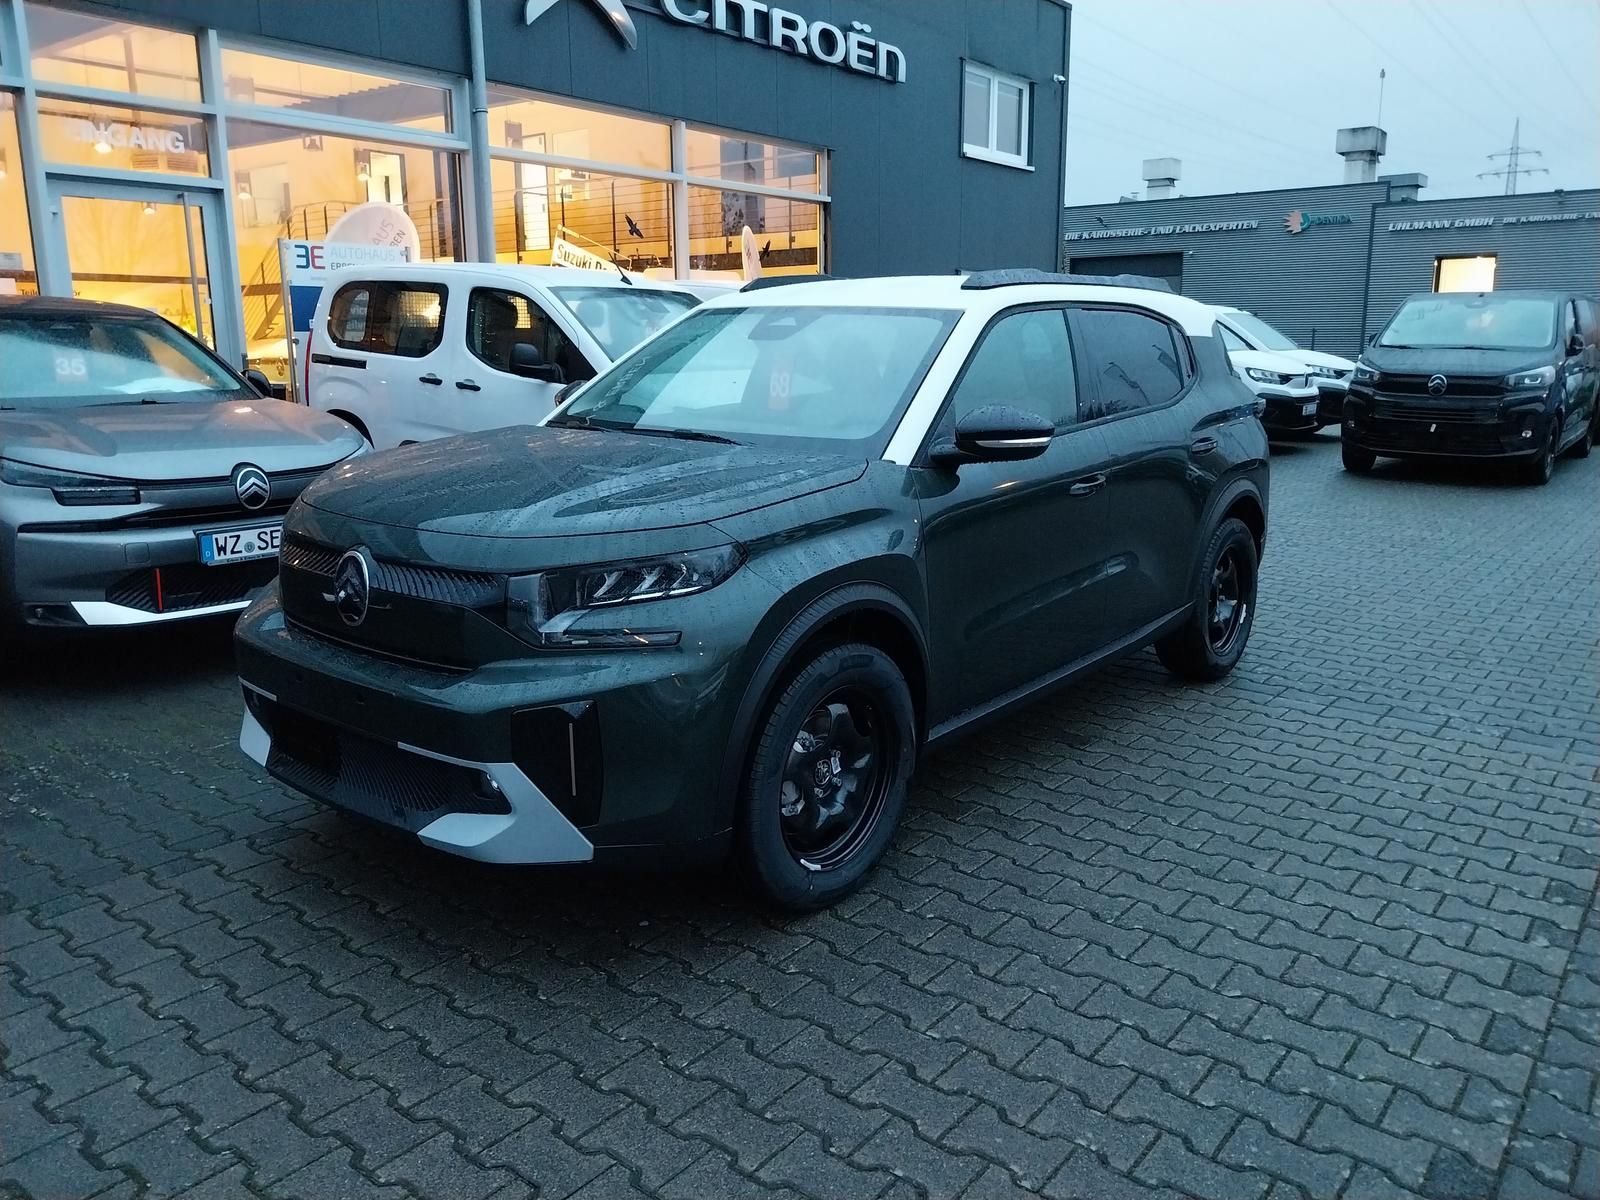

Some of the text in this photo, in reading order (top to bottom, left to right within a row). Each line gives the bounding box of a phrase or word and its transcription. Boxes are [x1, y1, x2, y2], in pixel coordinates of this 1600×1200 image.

[556, 242, 594, 271] Suzuki
[55, 357, 87, 375] 35
[215, 534, 242, 557] WZ
